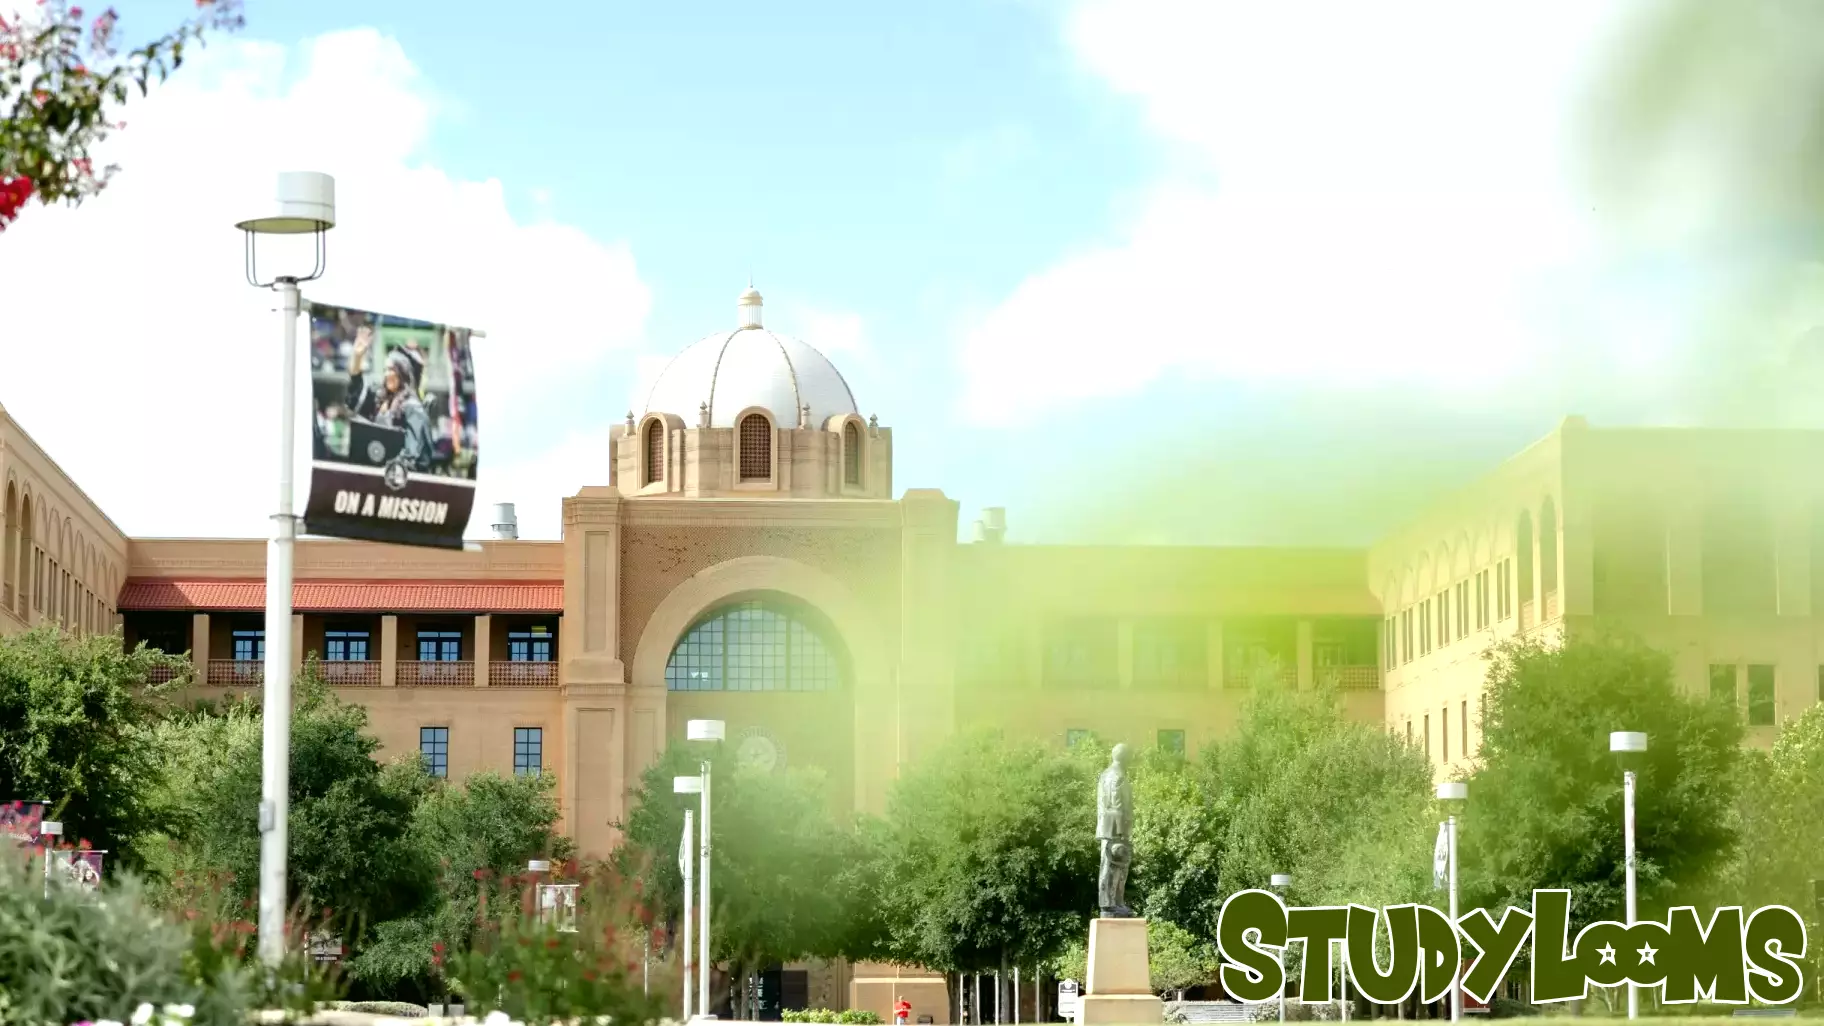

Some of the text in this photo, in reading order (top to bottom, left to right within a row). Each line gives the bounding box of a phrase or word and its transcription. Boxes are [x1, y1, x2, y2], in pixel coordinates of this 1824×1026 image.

[334, 489, 448, 525] ON A MISSION
